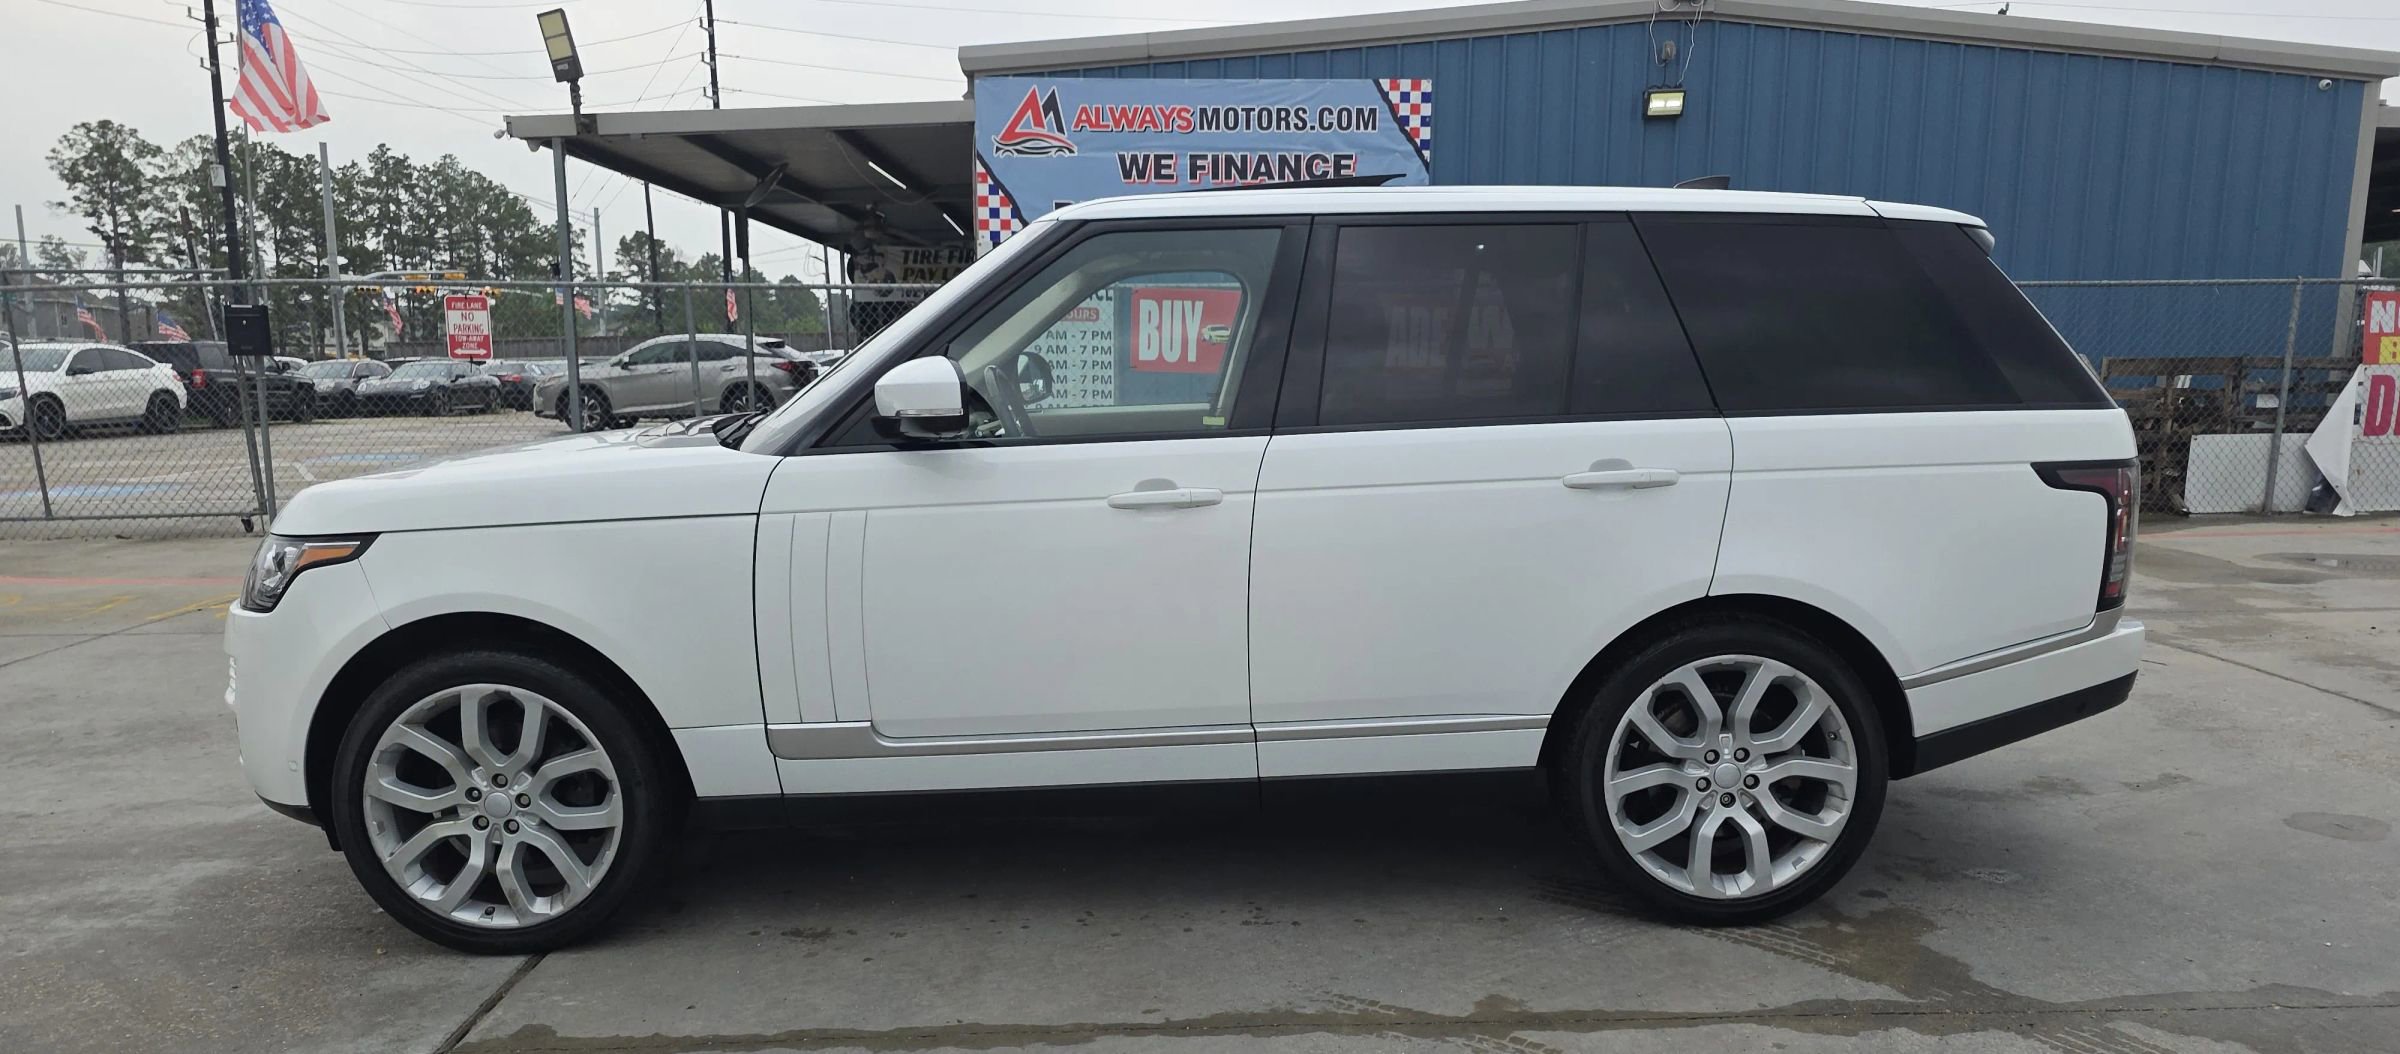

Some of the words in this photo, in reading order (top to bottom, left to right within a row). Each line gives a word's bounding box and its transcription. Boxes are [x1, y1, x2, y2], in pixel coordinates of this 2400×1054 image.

[1116, 152, 1176, 184] WE
[1188, 152, 1357, 184] FINANCE
[901, 249, 942, 264] TIRE
[902, 267, 938, 280] PAY
[452, 301, 465, 309] FIRE
[467, 301, 483, 309] LANE
[461, 311, 474, 321] NO
[1065, 308, 1098, 320] OURS
[453, 323, 484, 334] PARKING
[1138, 299, 1204, 362] BUY
[1046, 330, 1067, 340] AM
[1079, 330, 1088, 340] 7
[1092, 330, 1112, 340] PM
[1034, 344, 1042, 354] 9
[1046, 345, 1067, 354] AM
[1079, 345, 1088, 355] 7
[1092, 345, 1112, 355] PM
[1079, 360, 1088, 369] 7
[1092, 360, 1112, 369] PM
[1079, 374, 1088, 384] 7
[1092, 374, 1112, 384] PM
[1079, 389, 1088, 399] 7
[1092, 389, 1112, 399] PM
